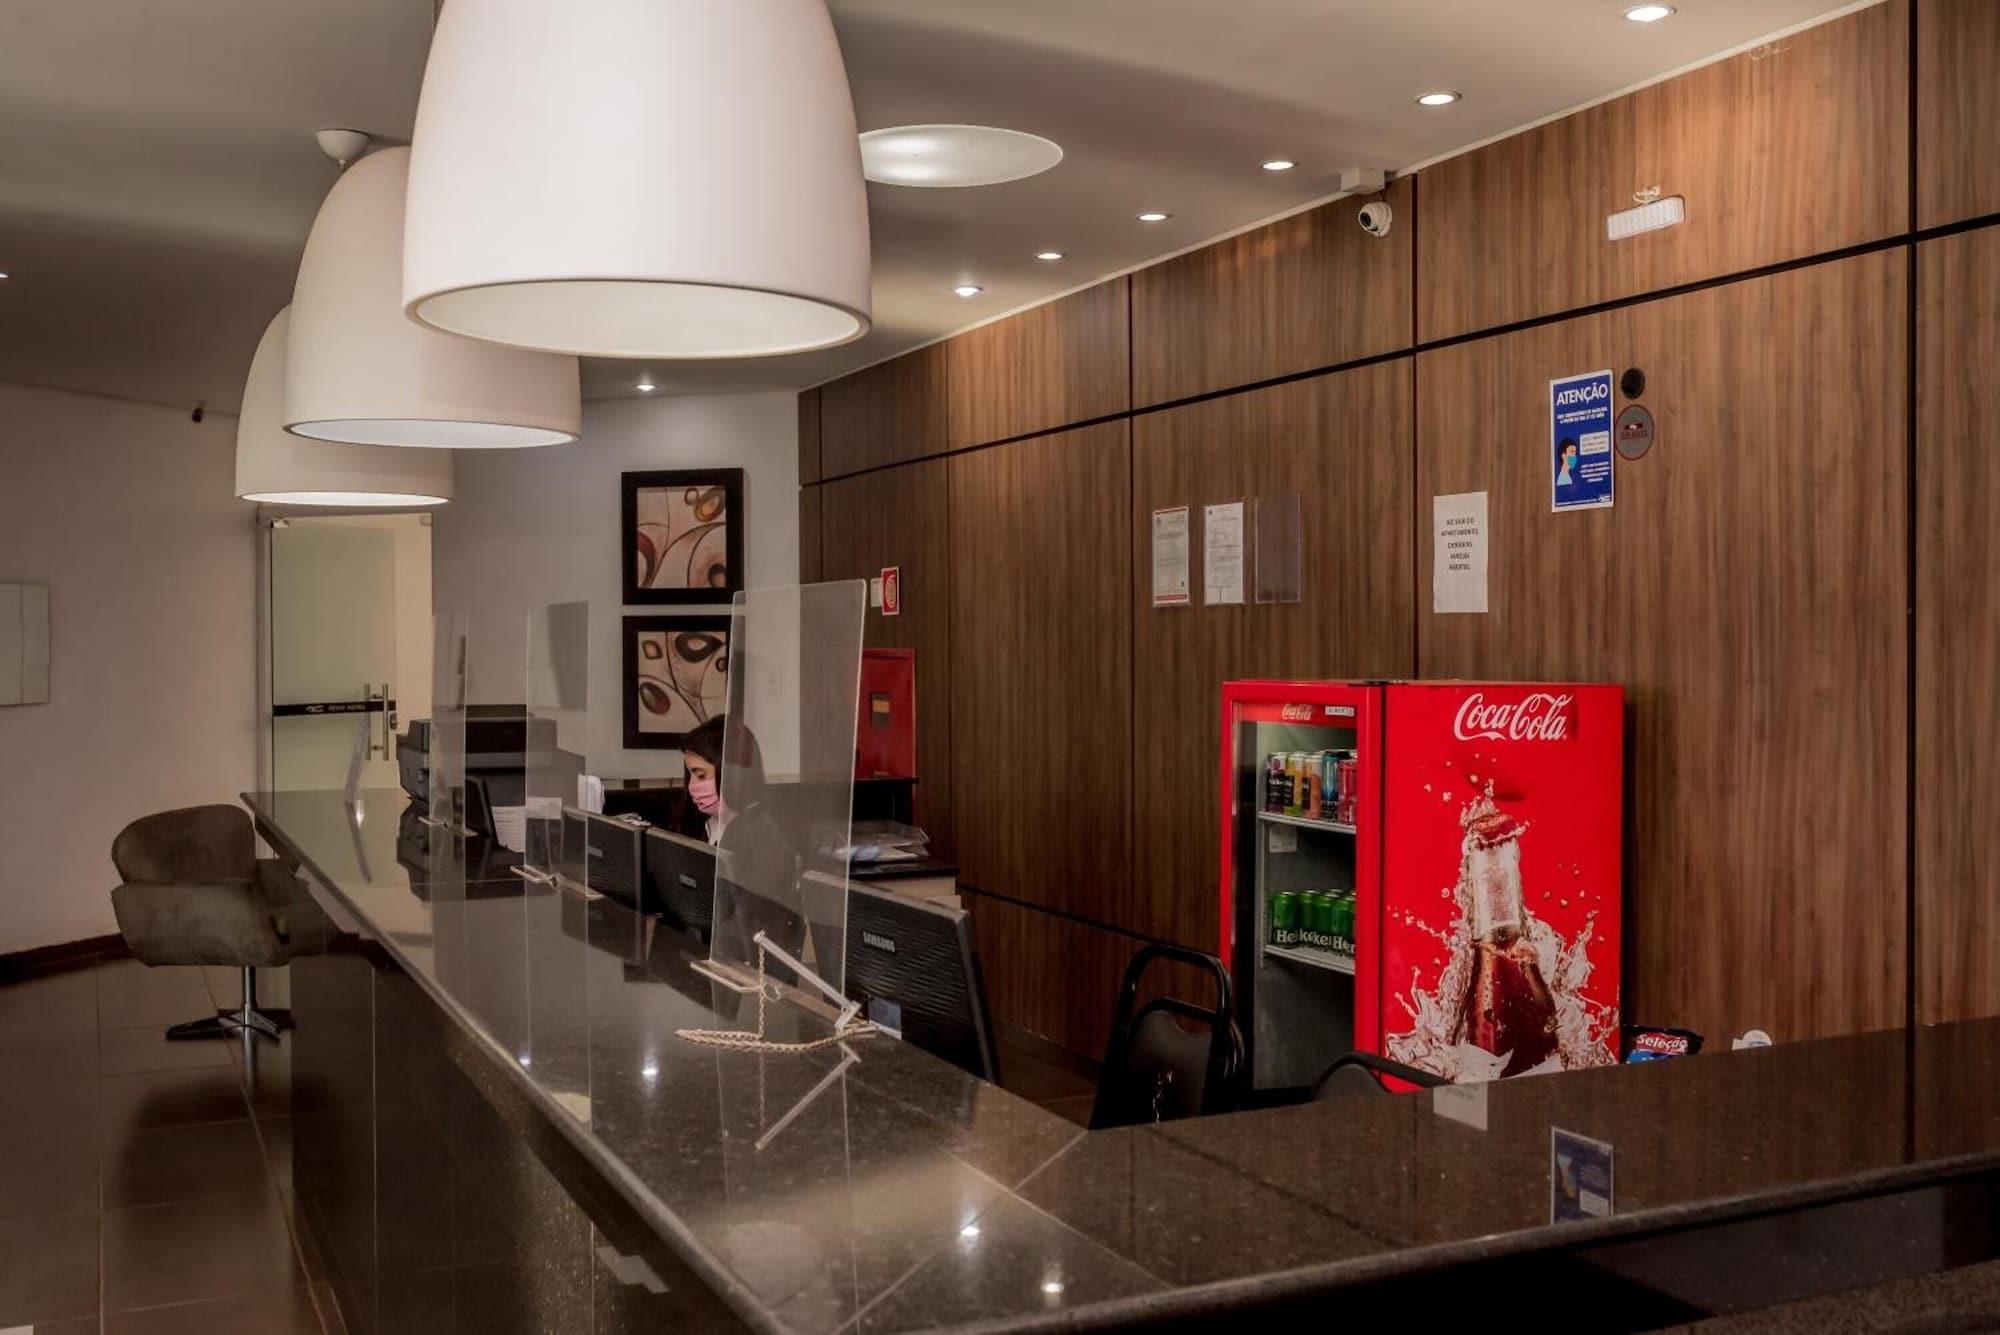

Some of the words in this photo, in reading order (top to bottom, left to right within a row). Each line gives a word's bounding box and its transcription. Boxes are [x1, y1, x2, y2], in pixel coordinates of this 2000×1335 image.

[1556, 382, 1608, 405] ATENÇÃO
[1453, 692, 1575, 741] Coca-Cola
[1637, 1034, 1688, 1051] Seleção
